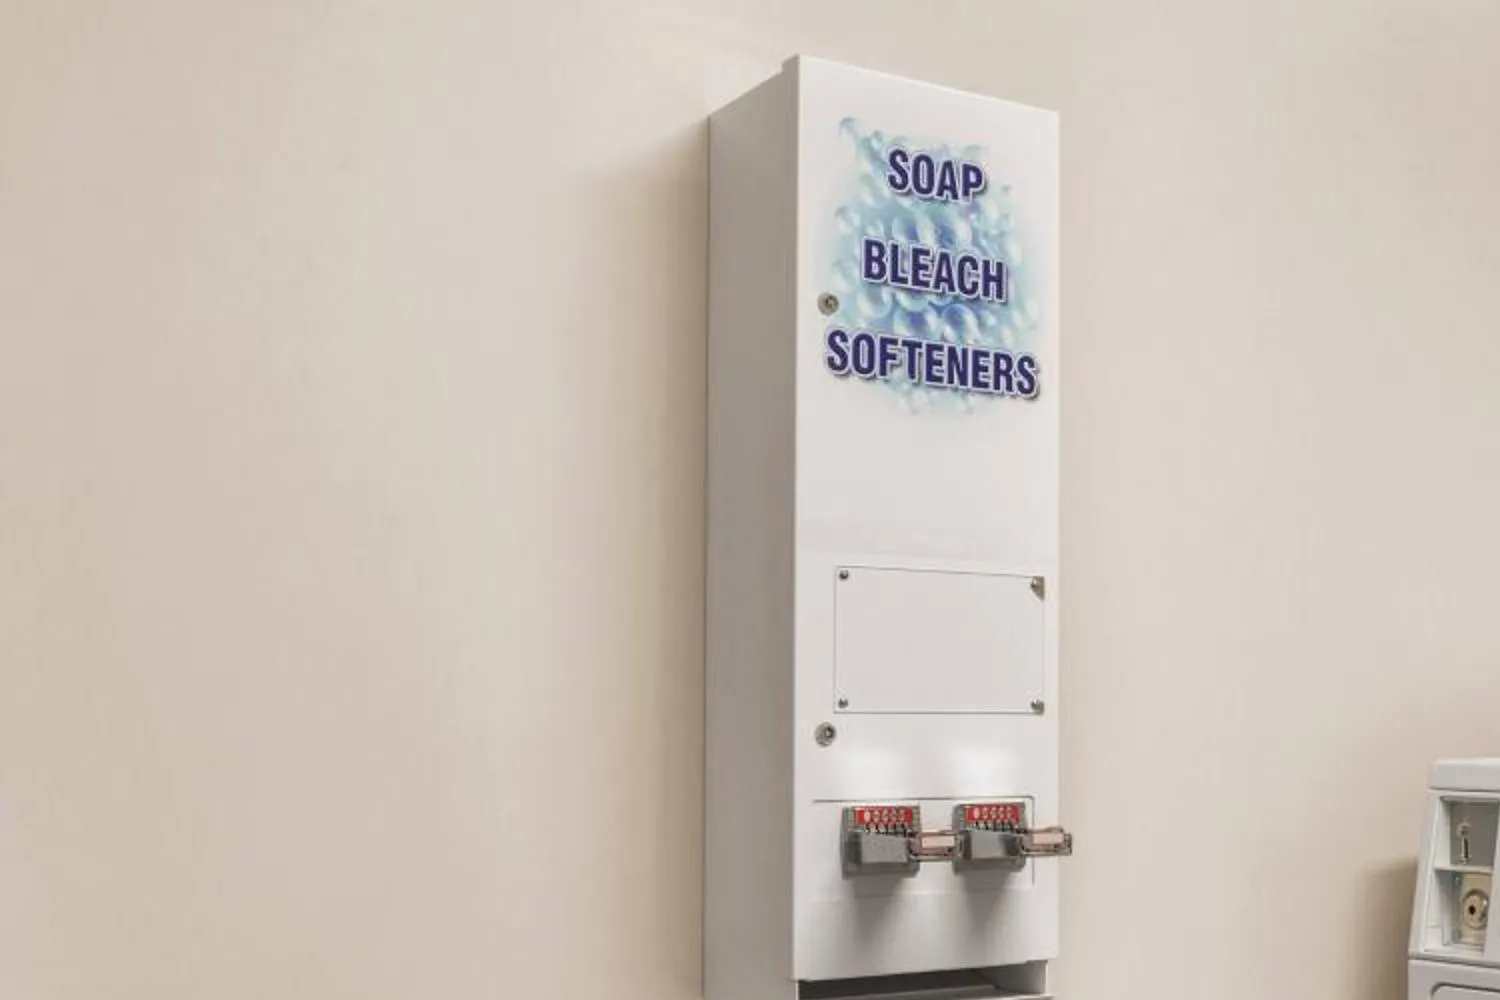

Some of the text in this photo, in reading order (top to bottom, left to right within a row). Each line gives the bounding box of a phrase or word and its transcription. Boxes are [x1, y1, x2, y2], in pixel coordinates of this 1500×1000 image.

[888, 148, 985, 201] SOAP
[863, 239, 1008, 301] BLEACH
[826, 329, 1038, 396] SOFTENERS
